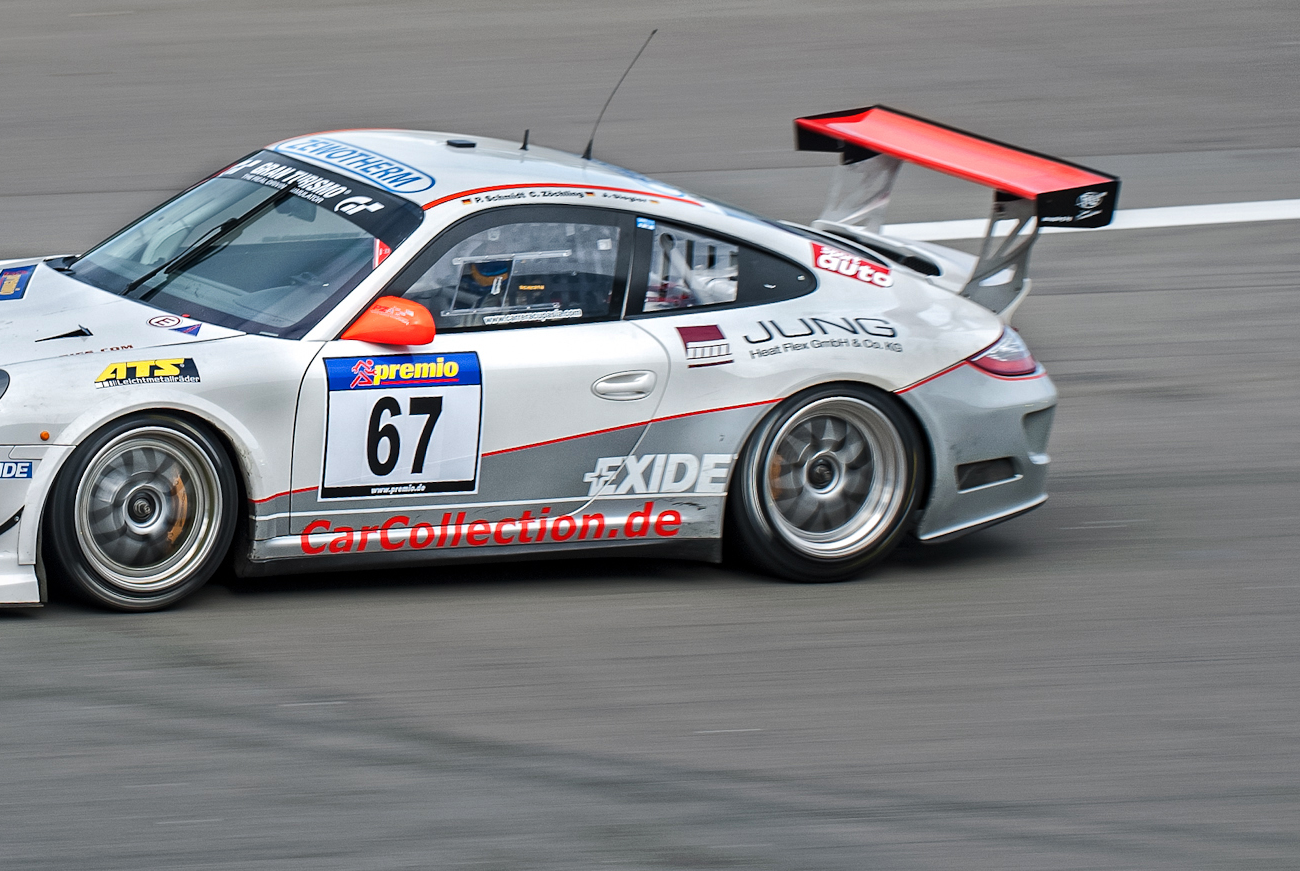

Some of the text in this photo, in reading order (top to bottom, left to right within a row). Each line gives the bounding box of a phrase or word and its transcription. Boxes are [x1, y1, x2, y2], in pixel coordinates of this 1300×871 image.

[285, 138, 423, 189] ZEWOTHERM
[249, 161, 349, 199] GRAN TURISMO
[528, 190, 540, 199] C.
[485, 191, 526, 203] Schmidt
[816, 254, 894, 288] auto
[743, 316, 898, 345] JUNG
[749, 337, 903, 360] Heat Flex GmbH & Co. KG
[95, 357, 185, 384] ATS
[117, 375, 200, 388] Leichtmetallräder
[373, 357, 460, 386] premio
[367, 395, 444, 477] 67
[371, 483, 427, 495] www.premio.de
[582, 453, 733, 497] EXIDE
[299, 502, 683, 555] CarCollection.de
